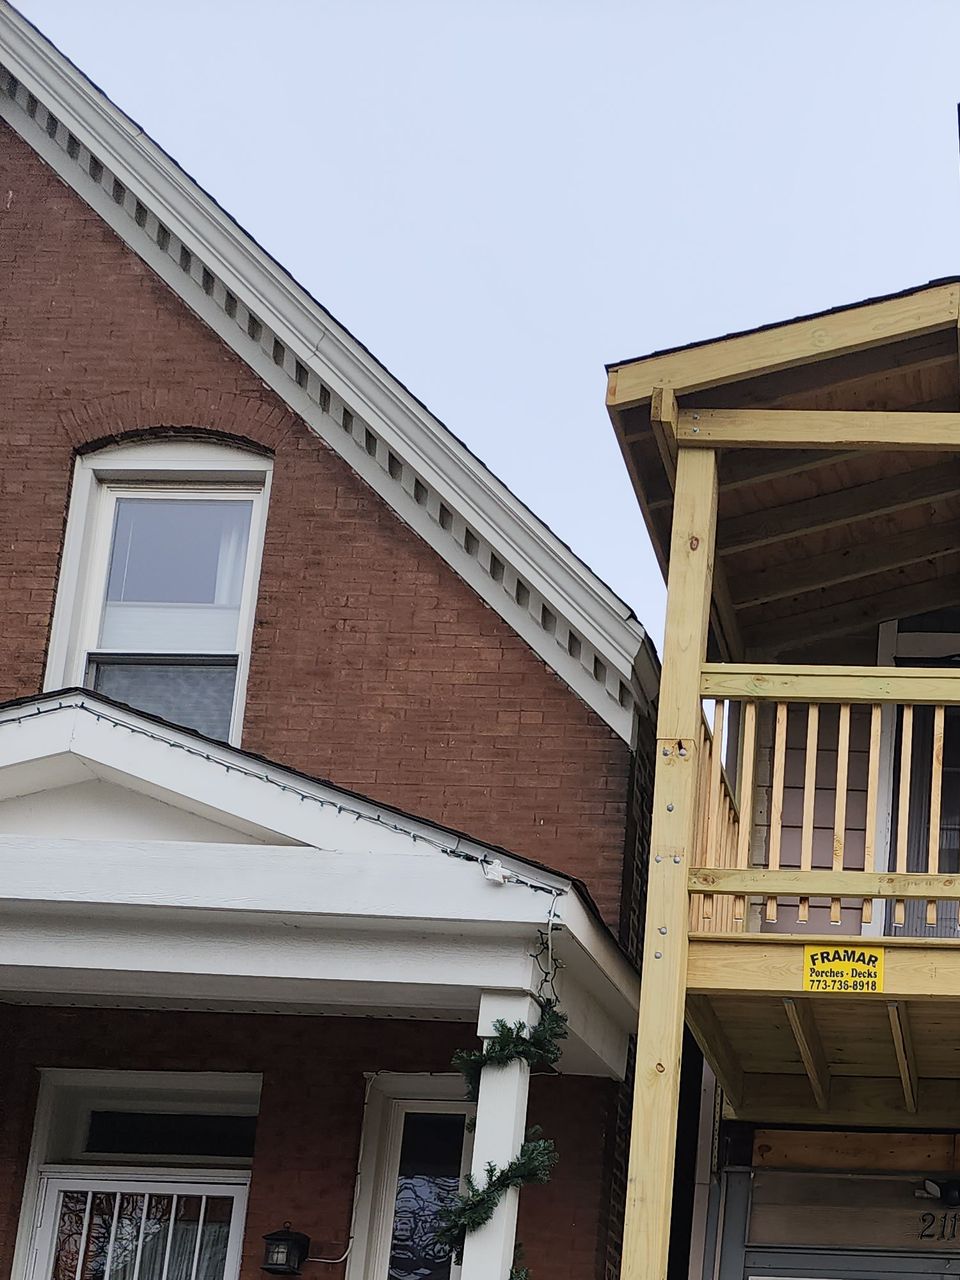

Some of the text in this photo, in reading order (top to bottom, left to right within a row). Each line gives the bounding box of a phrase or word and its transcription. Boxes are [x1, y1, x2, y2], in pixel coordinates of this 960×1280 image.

[810, 950, 878, 968] FRAMAR
[809, 968, 877, 979] Porches Decks
[809, 980, 877, 991] 773-736-8918
